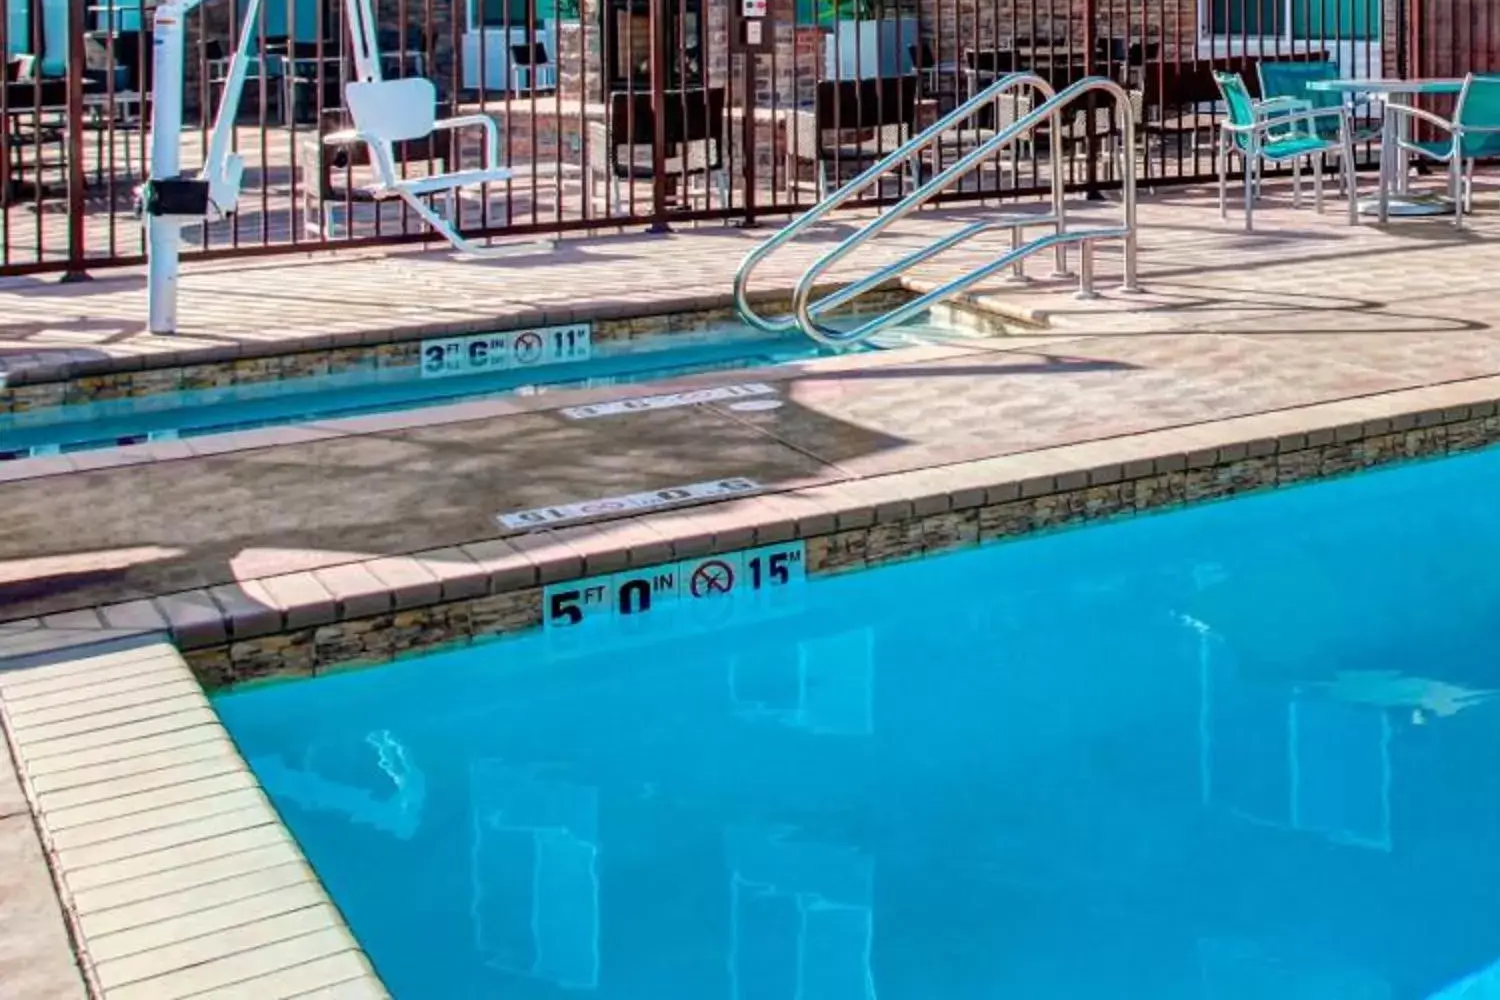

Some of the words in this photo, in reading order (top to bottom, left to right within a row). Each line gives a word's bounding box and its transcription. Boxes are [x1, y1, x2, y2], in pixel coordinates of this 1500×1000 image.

[551, 590, 583, 626] 5
[585, 584, 606, 604] FT
[619, 578, 651, 615] 0
[653, 572, 674, 591] IN
